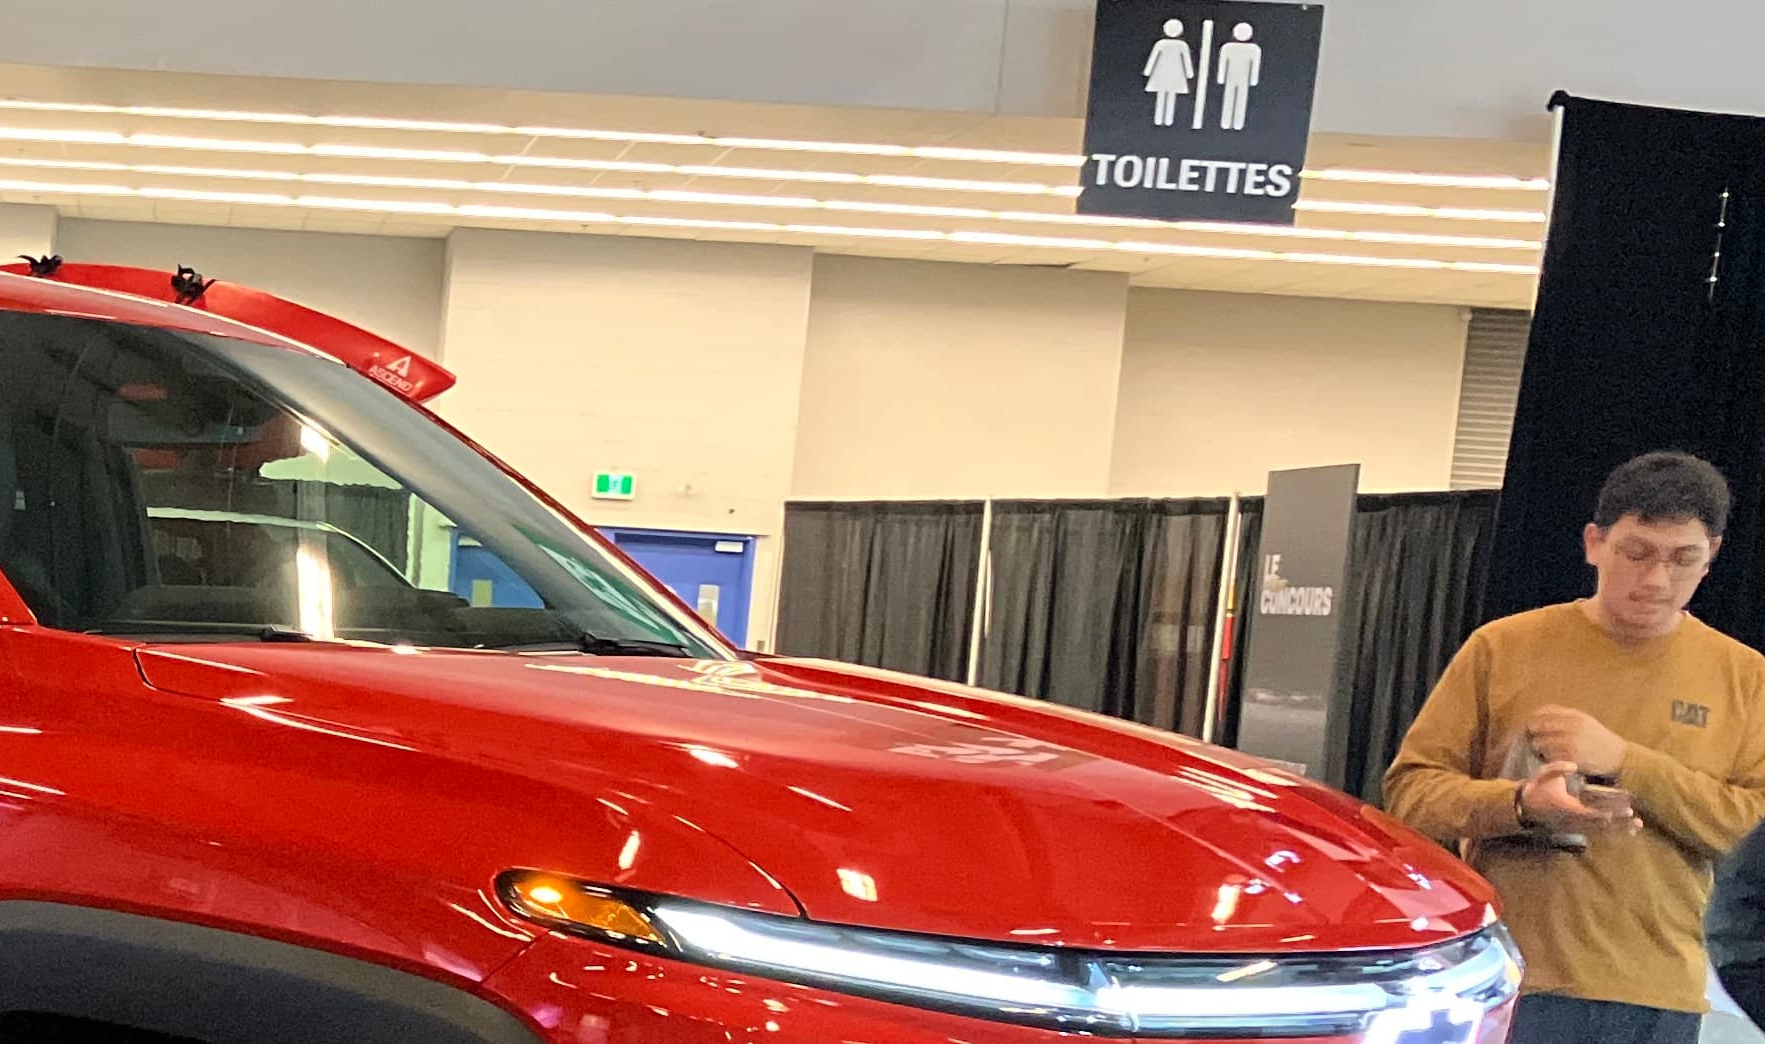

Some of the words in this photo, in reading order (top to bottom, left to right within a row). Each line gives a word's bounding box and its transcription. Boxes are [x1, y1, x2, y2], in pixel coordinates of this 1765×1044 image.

[1092, 153, 1293, 198] TOILETTES
[368, 365, 414, 392] ASCEND
[1264, 553, 1283, 579] LE
[1260, 587, 1333, 616] CONCOURS
[1671, 699, 1710, 729] CAT
